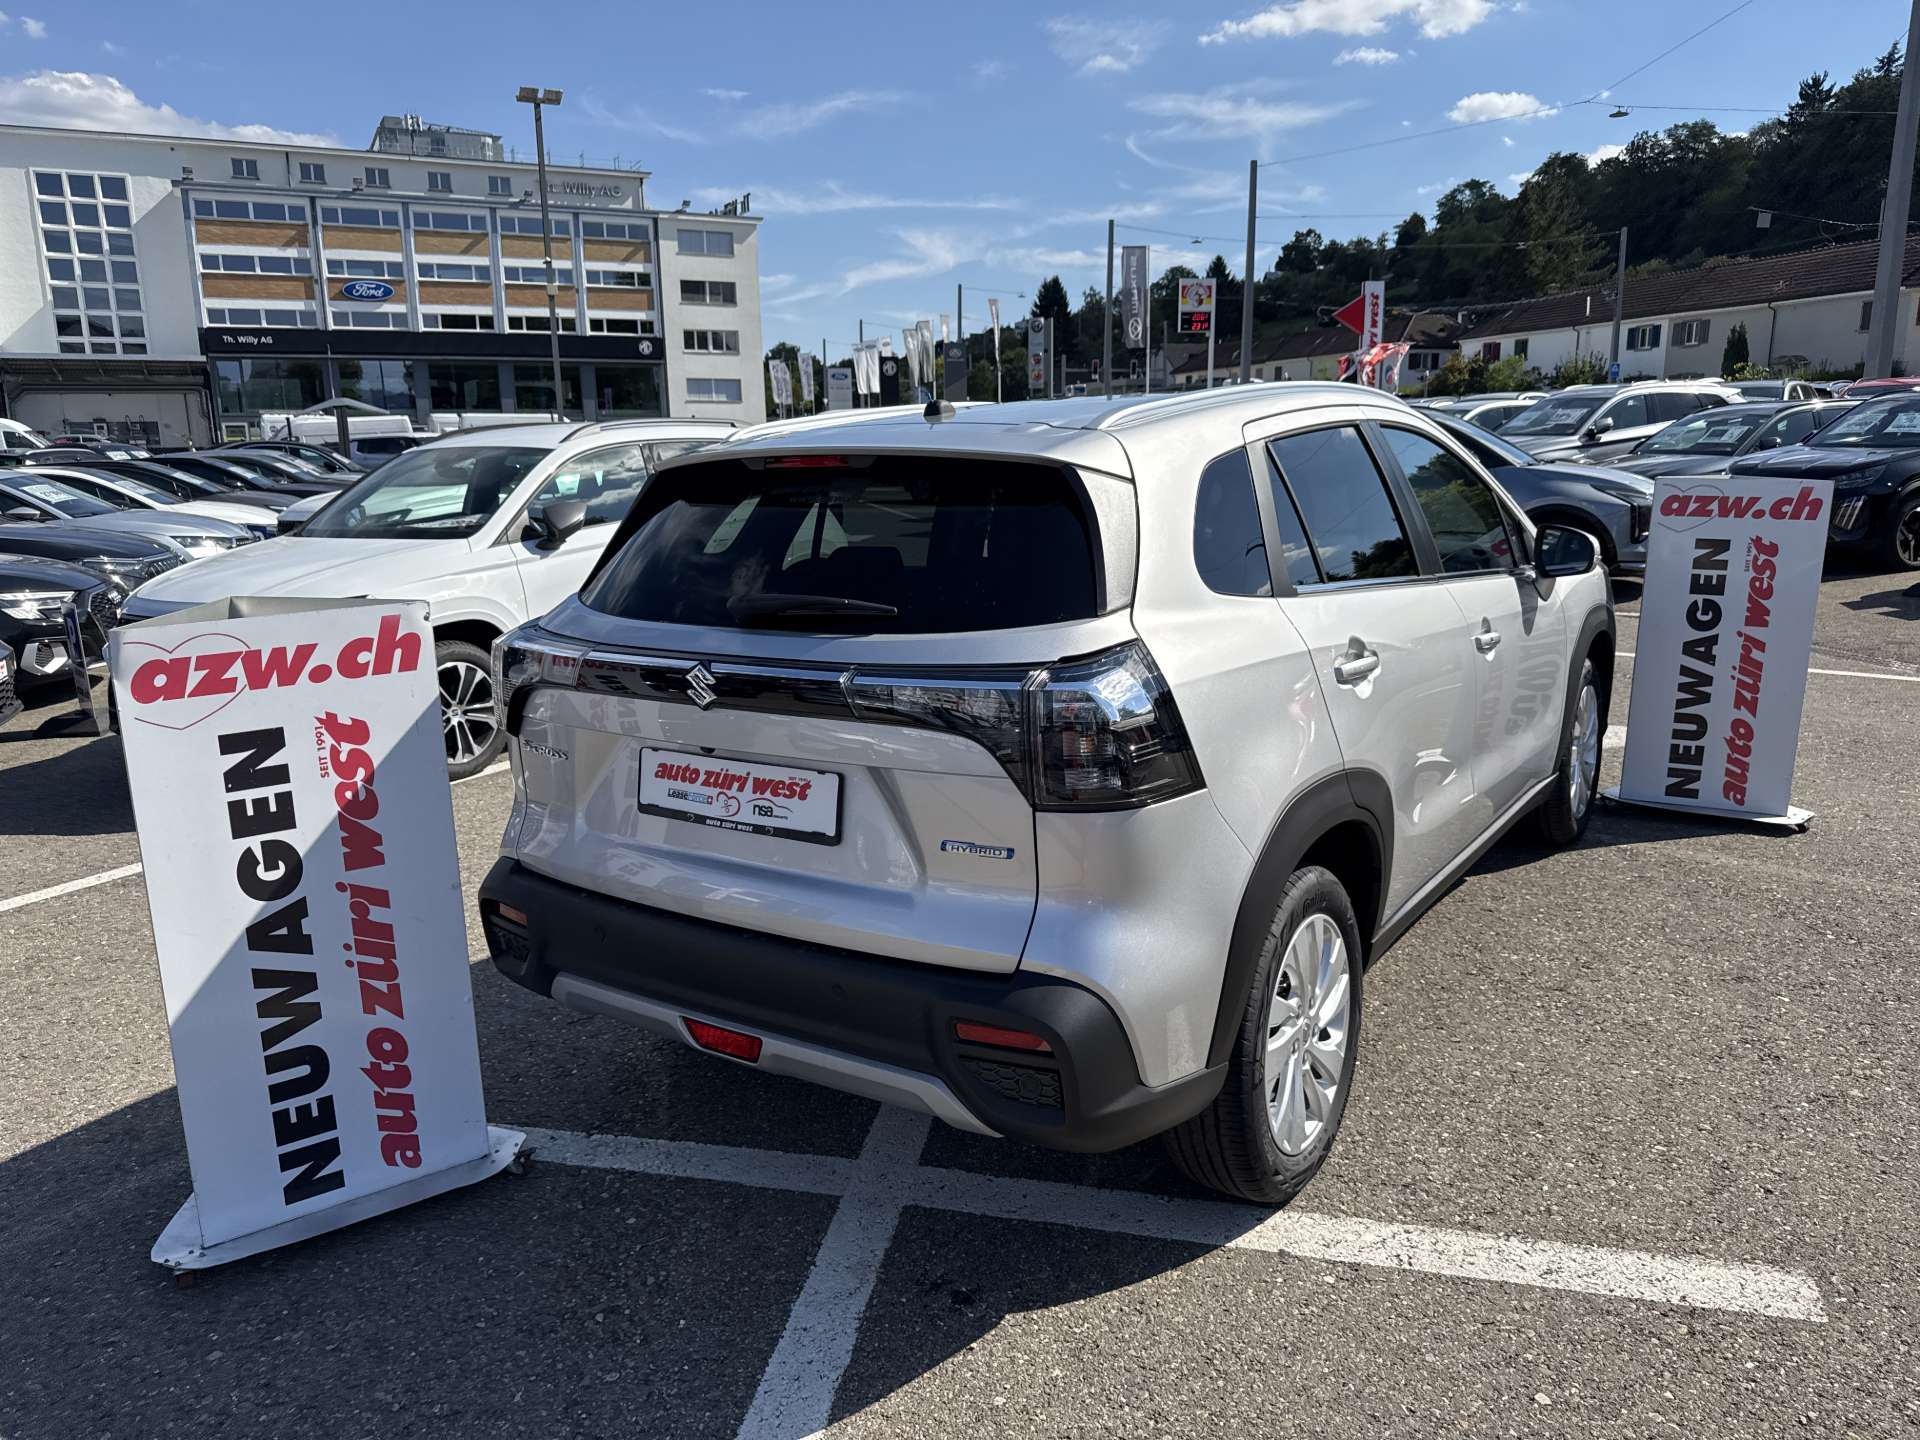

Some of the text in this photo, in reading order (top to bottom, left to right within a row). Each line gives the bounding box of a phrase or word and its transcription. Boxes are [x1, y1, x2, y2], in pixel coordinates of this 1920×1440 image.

[563, 182, 597, 198] Willy
[600, 185, 622, 197] AG
[352, 282, 385, 297] Ford
[222, 335, 273, 346] Th. Willy AG
[1660, 486, 1823, 521] azw.ch
[130, 614, 422, 705] azw.ch
[1664, 537, 1732, 801] NEUWAGEN
[1722, 535, 1780, 806] auto züri west
[315, 725, 330, 779] SEIT 1991
[654, 761, 812, 801] auto züri west
[705, 818, 721, 827] auto
[736, 823, 754, 832] west
[752, 804, 773, 818] nsa
[950, 844, 1003, 857] HYBRID
[314, 710, 423, 1169] auto züri west
[218, 726, 346, 1206] NEUWAGEN
